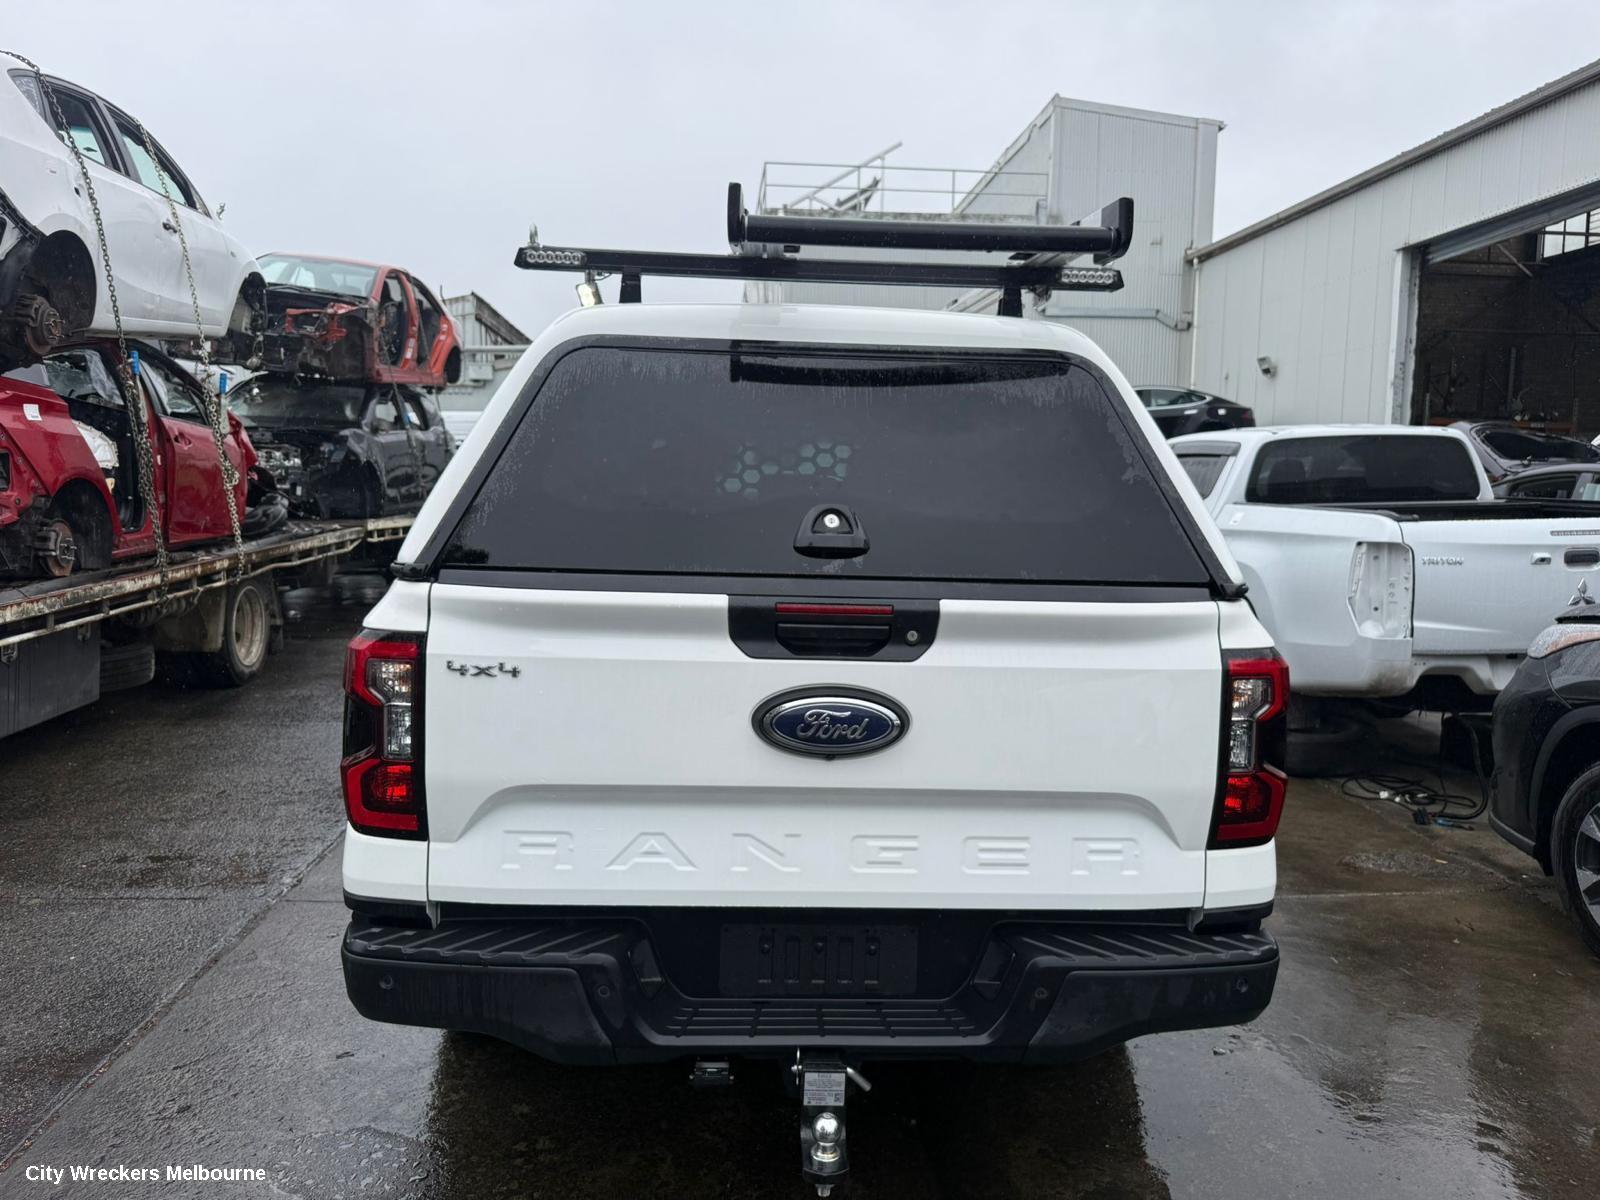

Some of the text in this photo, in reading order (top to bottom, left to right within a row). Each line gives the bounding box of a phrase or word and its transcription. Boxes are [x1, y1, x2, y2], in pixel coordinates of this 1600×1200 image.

[1421, 555, 1464, 566] TRITON
[796, 709, 870, 740] Ford
[501, 830, 1140, 875] RANGER
